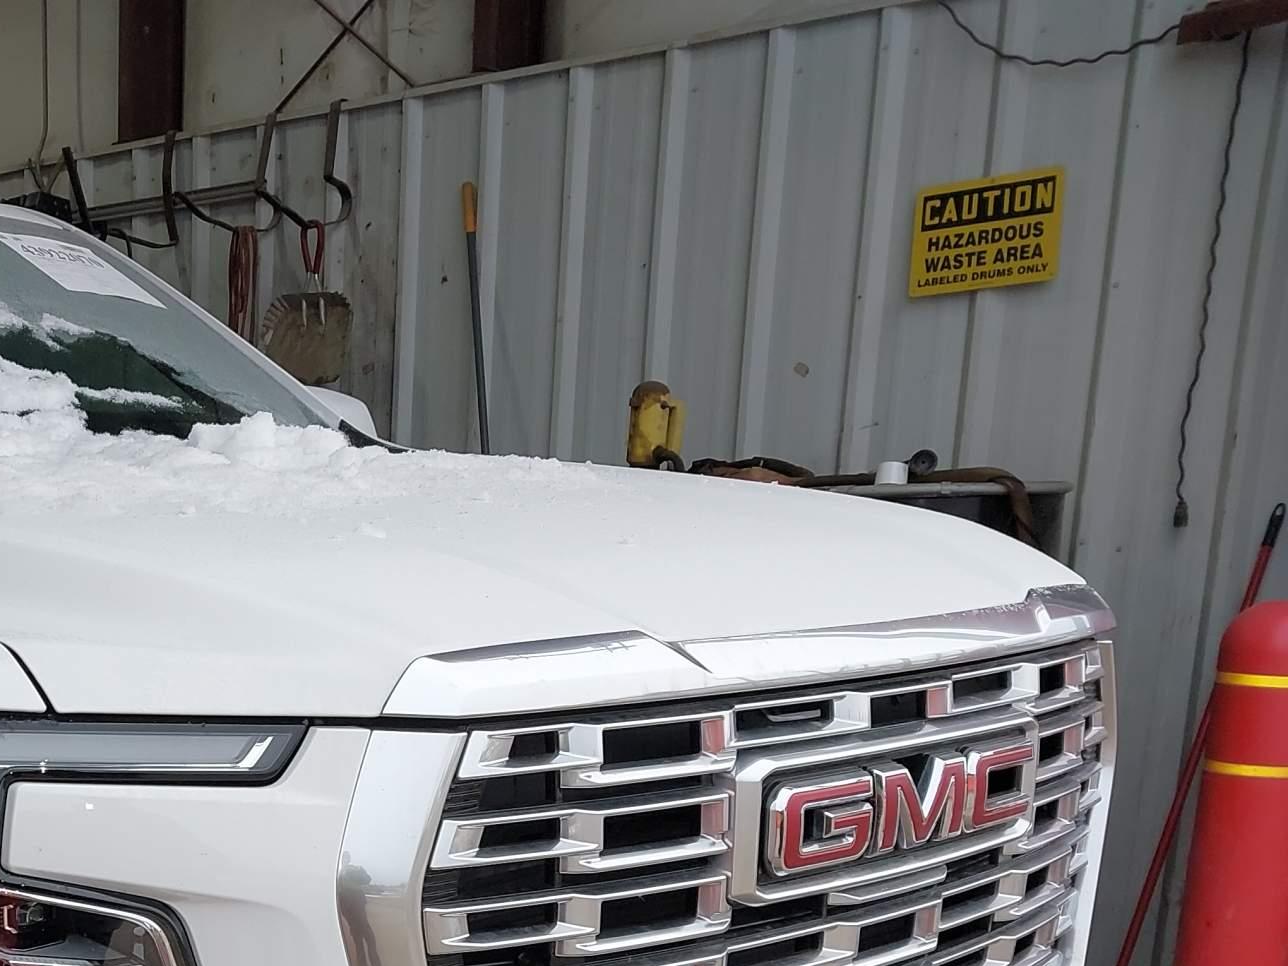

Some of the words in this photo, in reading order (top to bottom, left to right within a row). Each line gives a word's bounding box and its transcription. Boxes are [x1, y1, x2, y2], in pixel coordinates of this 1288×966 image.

[924, 181, 1054, 226] CAUTION
[927, 221, 1045, 253] HAZARDOUS
[924, 250, 988, 274] WASTE
[993, 243, 1043, 265] AREA
[917, 273, 968, 288] LABELED
[971, 267, 1014, 281] DRUMS
[1017, 262, 1049, 275] ONLY
[769, 744, 1034, 877] GMC
